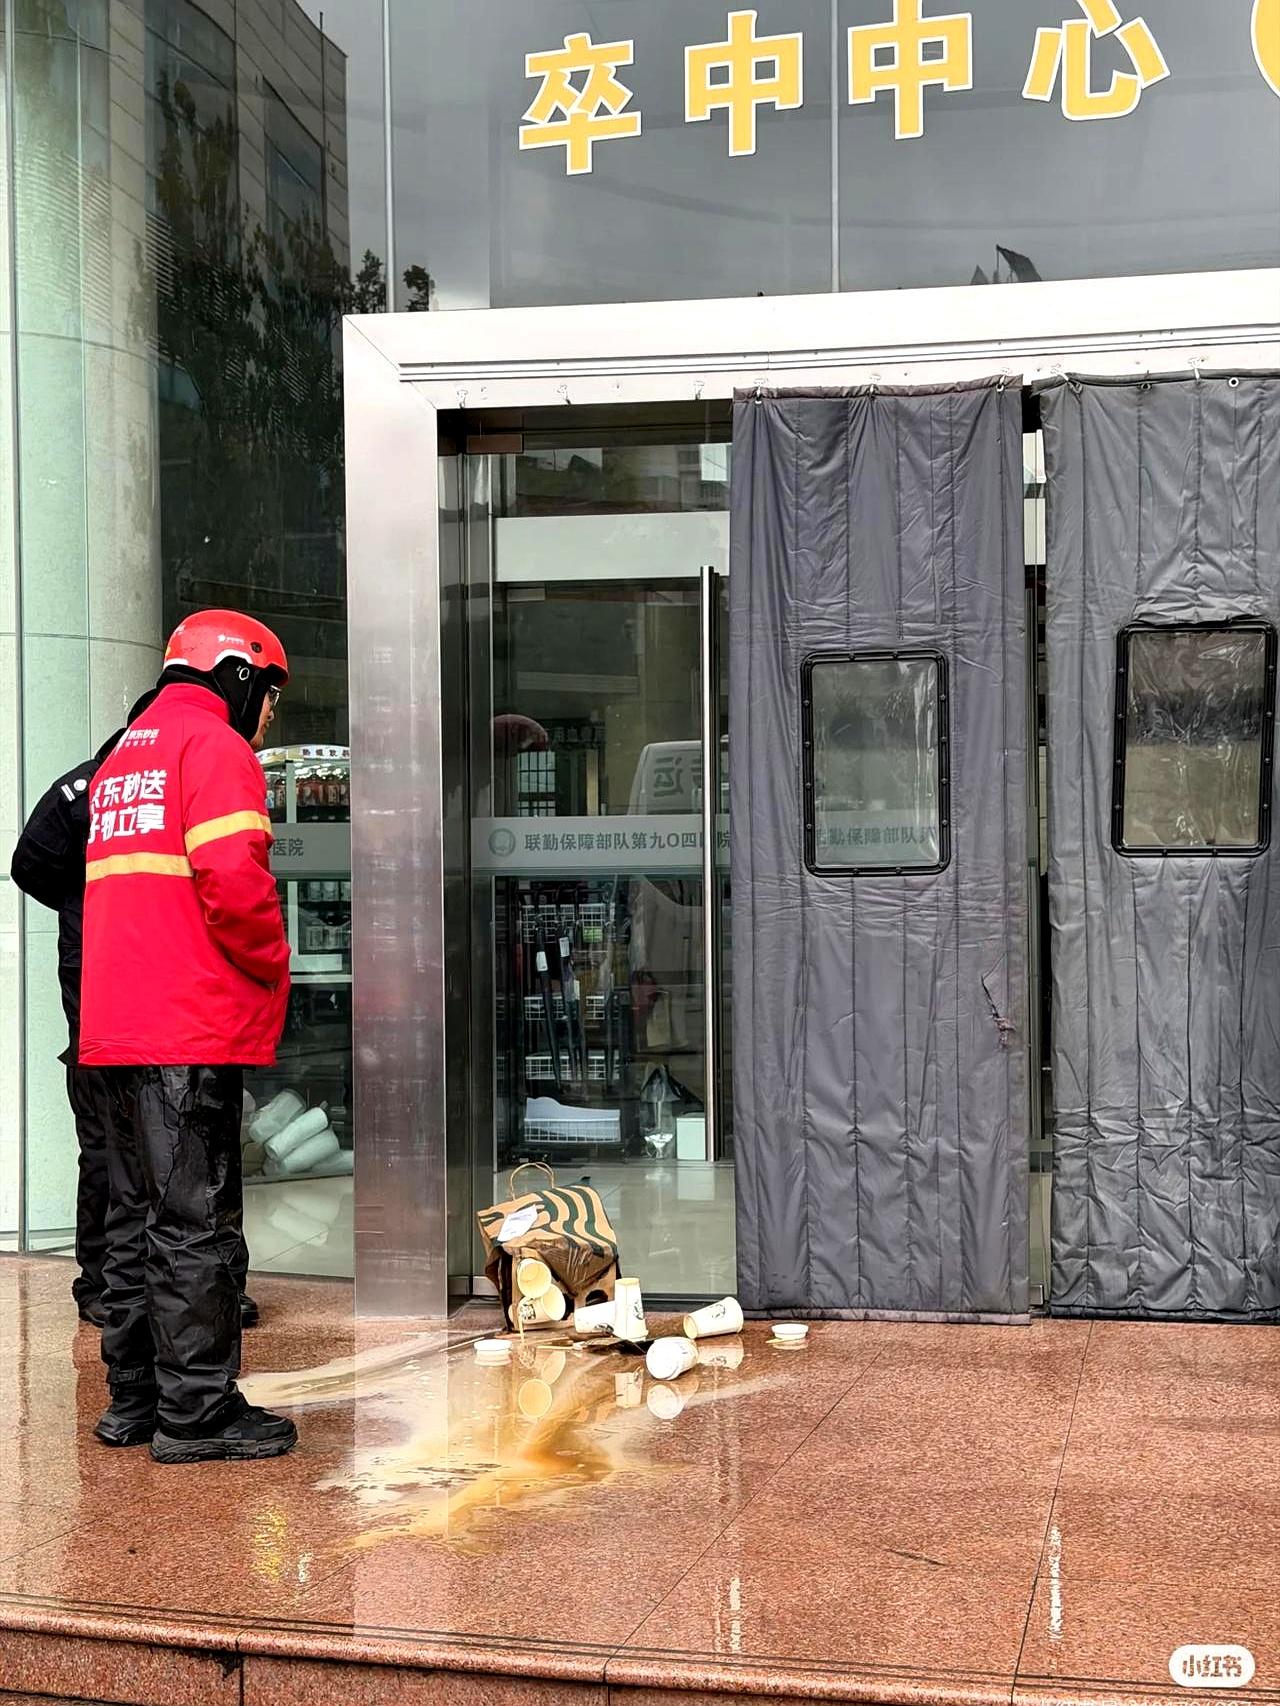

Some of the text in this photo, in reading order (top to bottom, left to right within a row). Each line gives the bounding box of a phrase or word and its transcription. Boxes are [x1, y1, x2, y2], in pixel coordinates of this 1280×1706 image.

[519, 0, 1170, 175] 卒中中心
[272, 838, 304, 857] 医院
